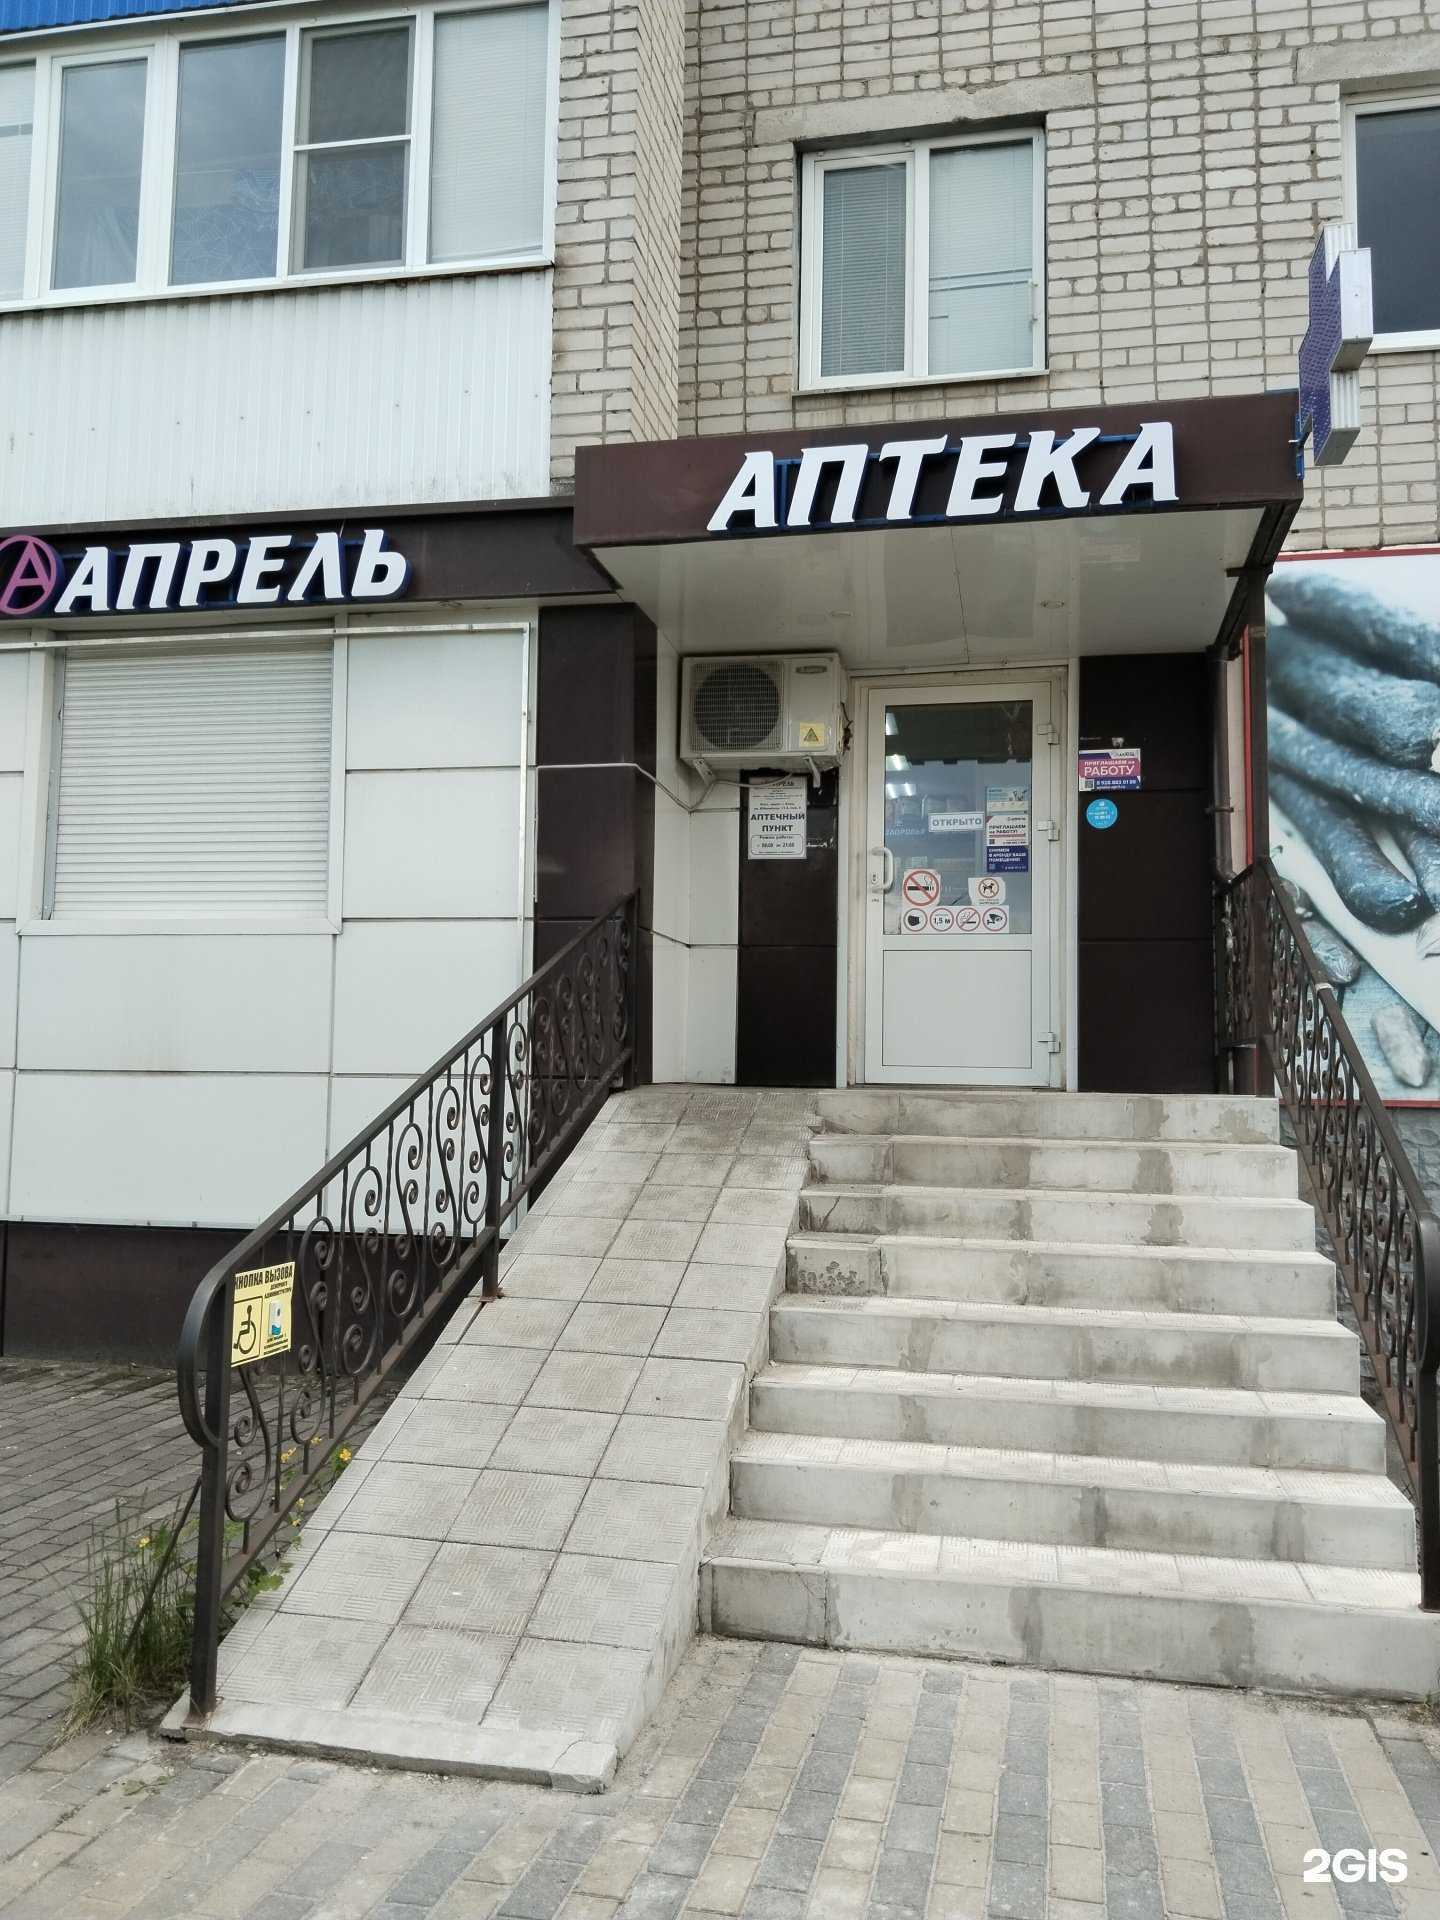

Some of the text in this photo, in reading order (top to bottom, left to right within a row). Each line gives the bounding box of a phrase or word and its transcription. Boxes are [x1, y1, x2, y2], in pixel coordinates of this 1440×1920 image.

[706, 421, 1180, 532] АПТЕКА
[54, 528, 408, 613] АПРЕЛЬ
[1084, 765, 1135, 777] РАБОТУ
[751, 813, 806, 821] АПТЕЧНЫЙ
[932, 817, 983, 827] ОТКРЫТО
[762, 824, 794, 832] ПУНКТ
[264, 1265, 293, 1284] ВЫЗОВА
